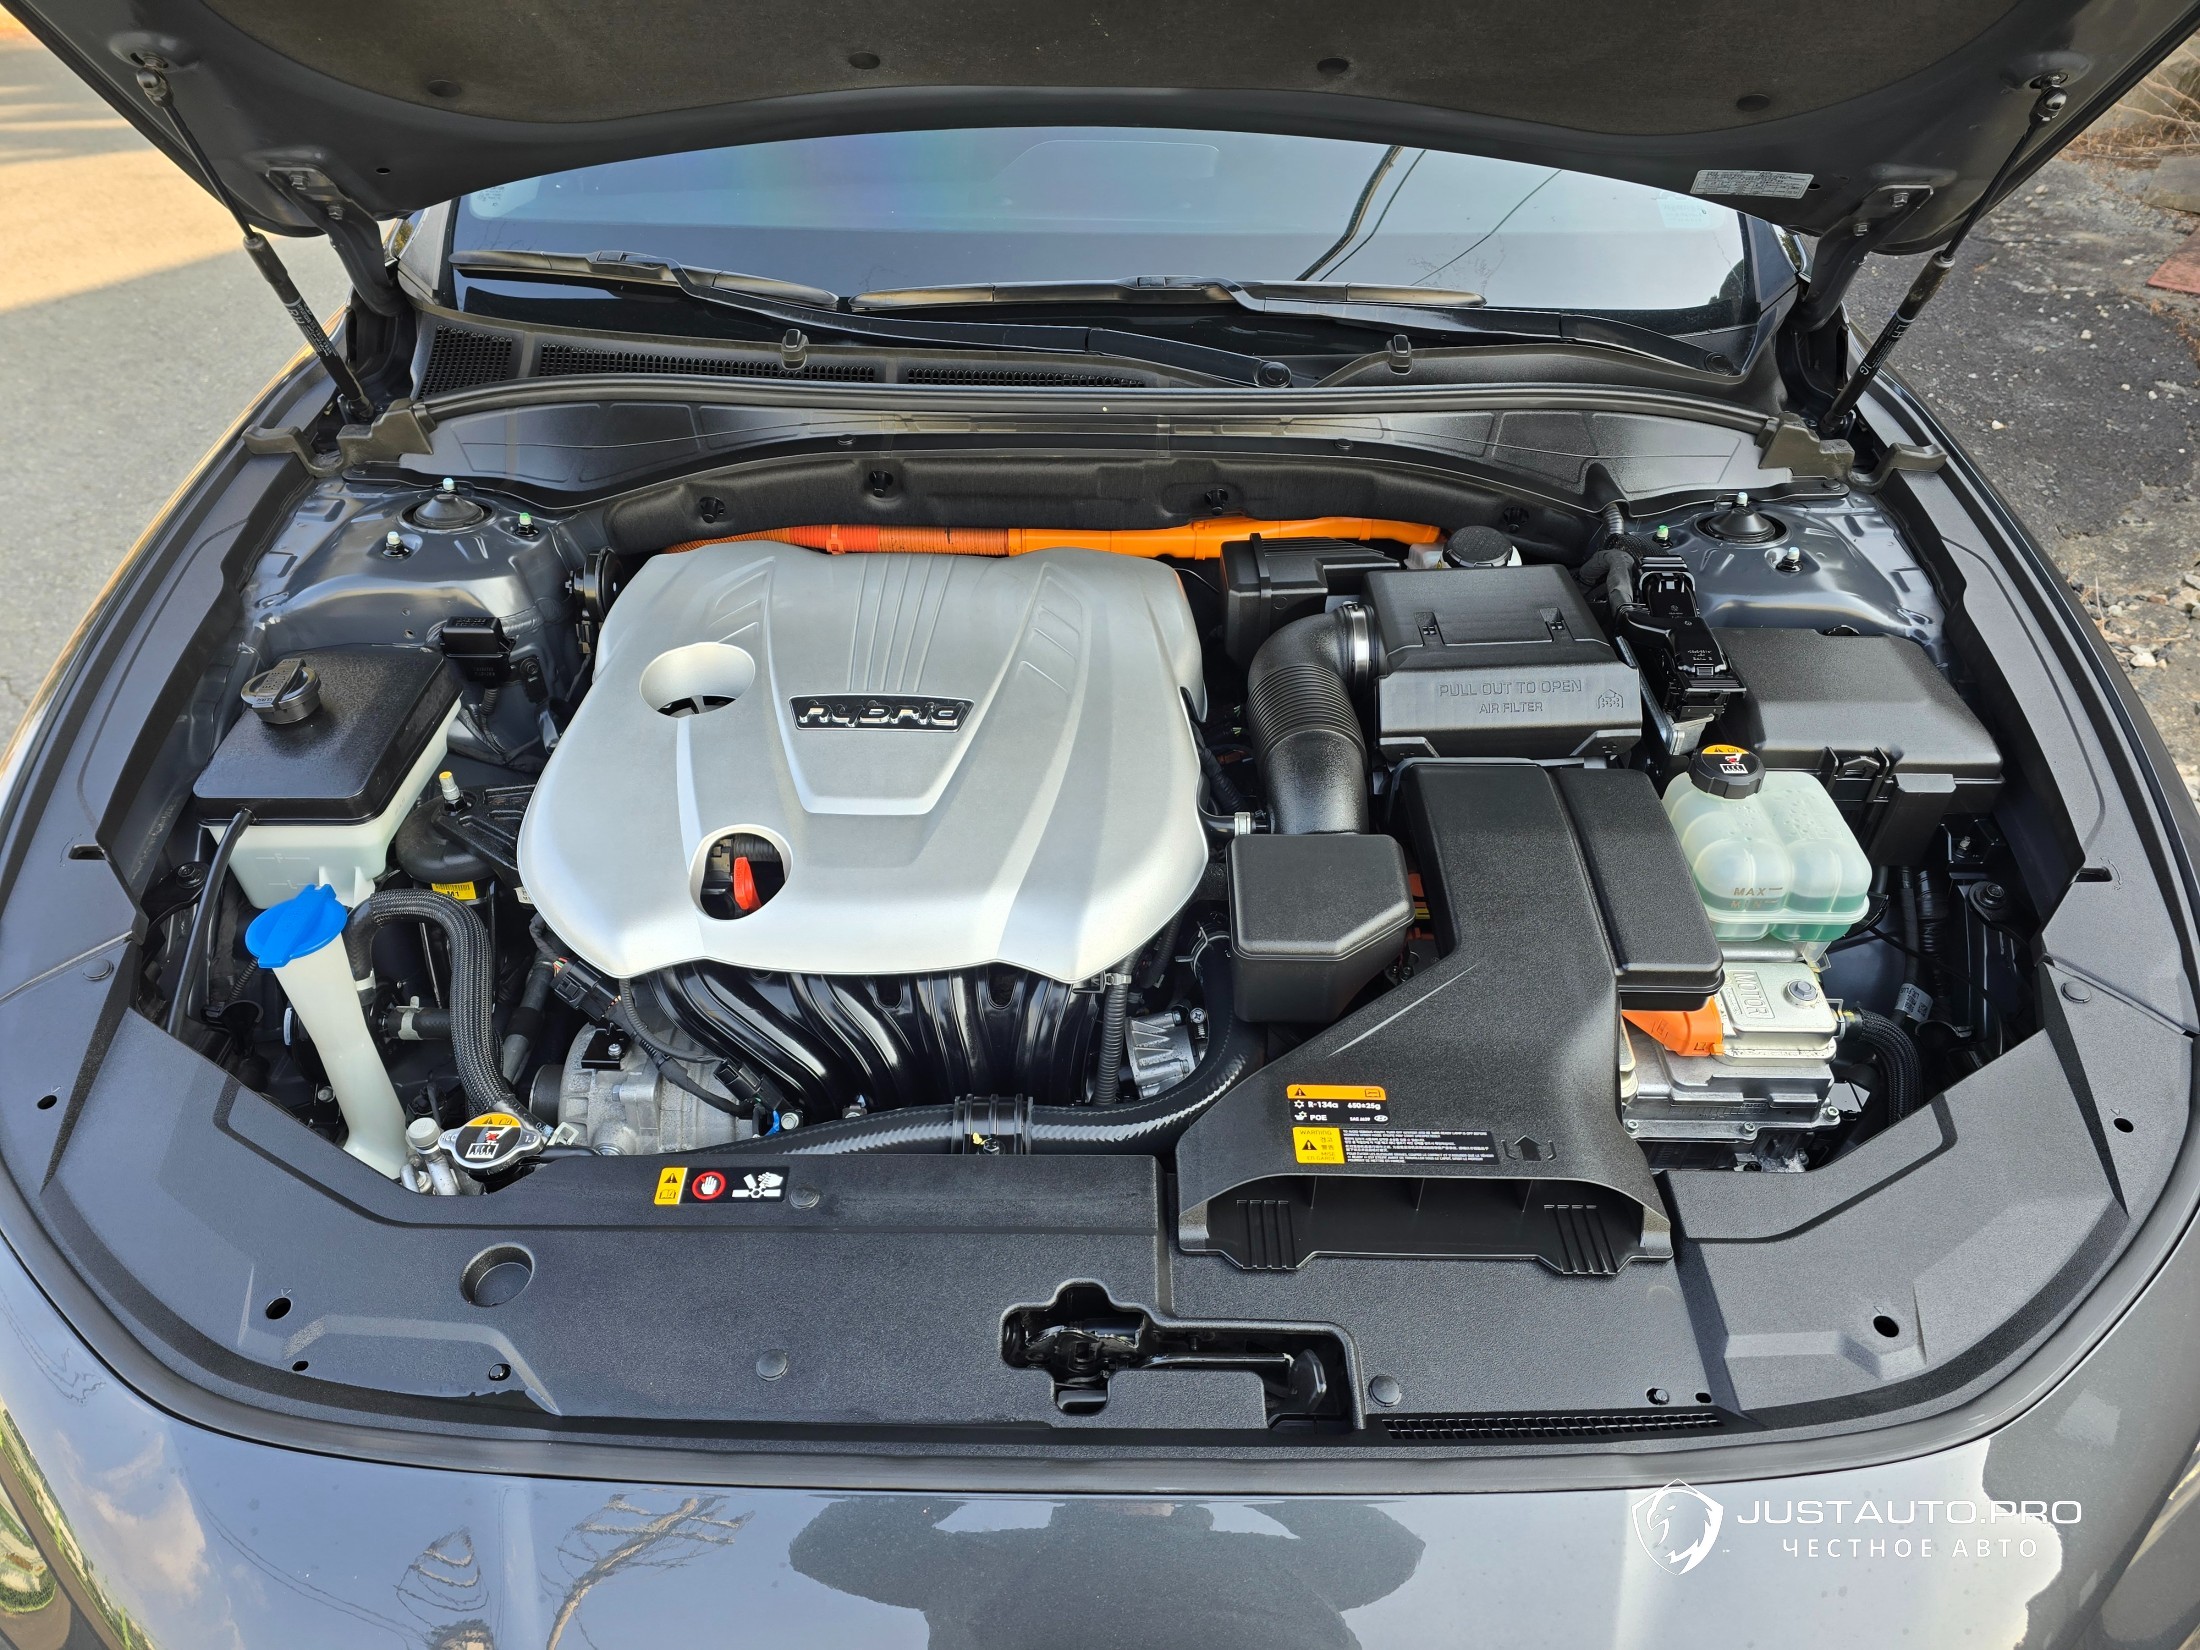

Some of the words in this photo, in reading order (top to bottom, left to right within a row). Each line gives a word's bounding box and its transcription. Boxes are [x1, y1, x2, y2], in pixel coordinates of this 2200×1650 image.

[1892, 324, 1910, 338] LH
[1439, 683, 1477, 697] PULL
[1482, 682, 1512, 696] OUT
[1516, 681, 1537, 695] TO
[1541, 679, 1582, 694] OPEN
[1479, 703, 1500, 715] AIR
[1502, 701, 1543, 714] FILTER
[1733, 887, 1766, 896] MAX
[1733, 972, 1769, 1015] MOTOR
[1307, 1101, 1339, 1109] R-134a
[524, 1135, 537, 1143] 1.1
